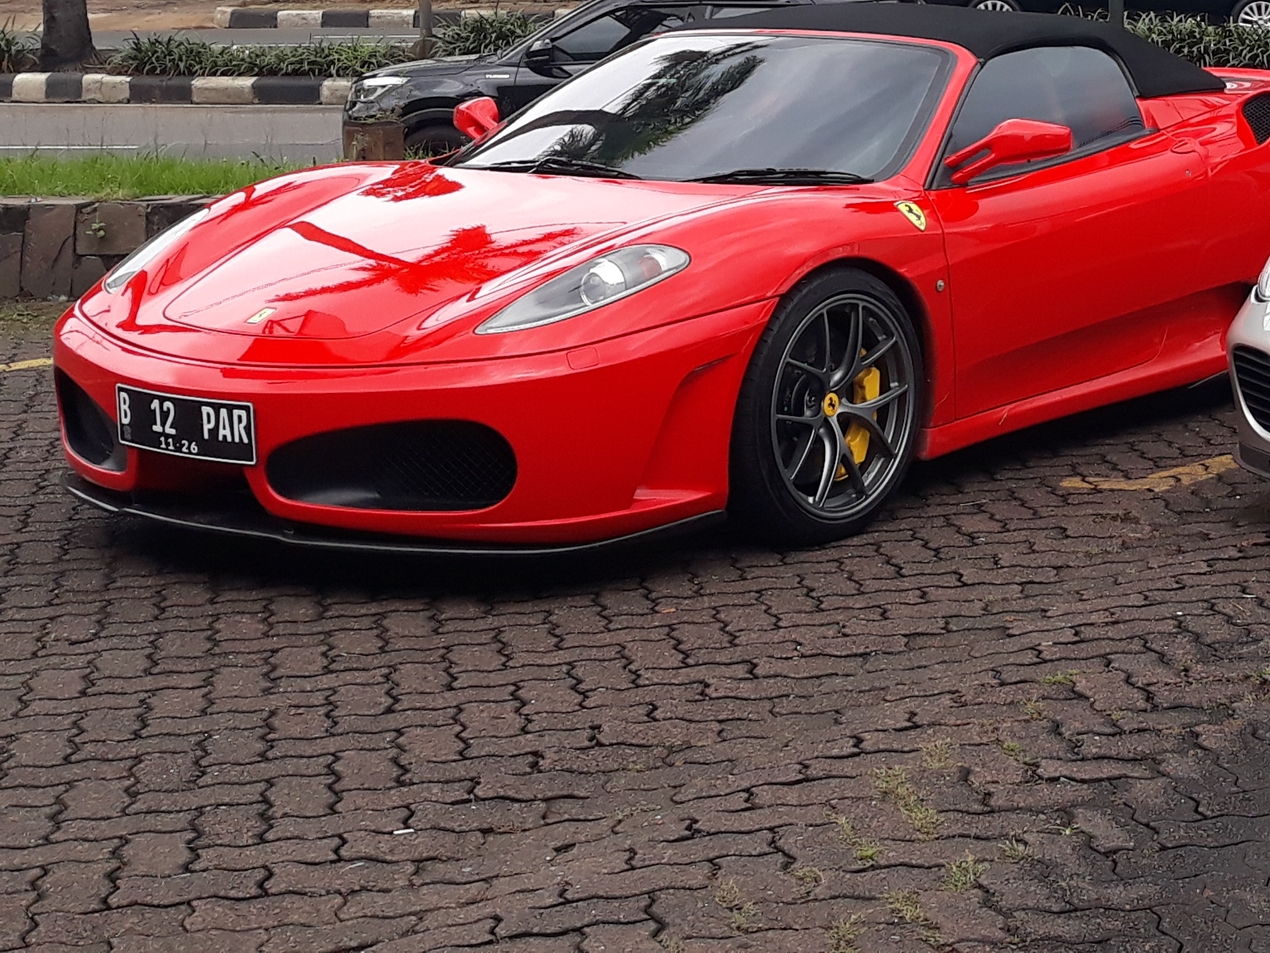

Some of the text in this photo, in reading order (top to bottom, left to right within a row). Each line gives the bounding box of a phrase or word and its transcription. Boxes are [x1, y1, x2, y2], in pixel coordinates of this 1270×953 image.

[119, 391, 249, 444] B 12 PAR
